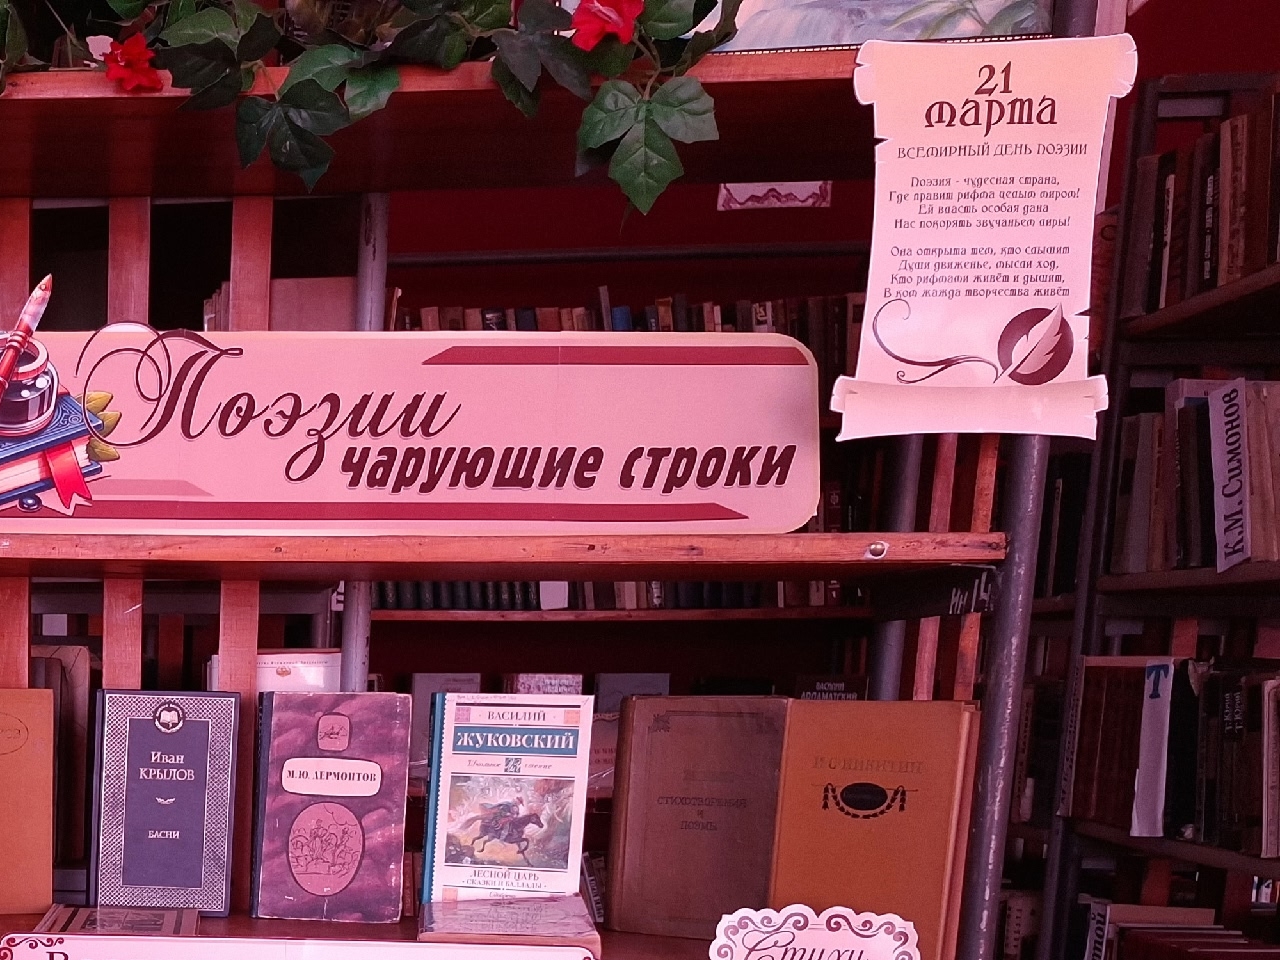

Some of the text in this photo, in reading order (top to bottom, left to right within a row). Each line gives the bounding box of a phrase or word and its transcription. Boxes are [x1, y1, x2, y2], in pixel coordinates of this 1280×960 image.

[975, 61, 1012, 96] 21
[925, 95, 1057, 137] марта
[898, 142, 1087, 159] ВСЕМИРНЫЙ ДЕНЬ ПОЭЗИИ
[911, 177, 951, 187] Поэзия
[964, 176, 1014, 187] чудесная
[889, 191, 909, 203] Где
[913, 191, 953, 201] правит
[958, 190, 994, 201] рифма
[999, 190, 1036, 199] целым
[918, 203, 1048, 215] Ей власть особая дана
[894, 219, 915, 229] Нас
[919, 218, 972, 230] покорять
[891, 247, 912, 256] Она
[916, 247, 966, 256] открыта
[1000, 247, 1021, 256] кто
[1025, 245, 1070, 255] слышит
[898, 260, 930, 272] Души
[996, 260, 1032, 269] мысли
[891, 275, 912, 284] Кто
[916, 274, 969, 285] рифмами
[1013, 275, 1019, 283] и
[884, 288, 891, 297] В
[895, 290, 917, 300] ком
[922, 288, 961, 299] жажда
[965, 288, 1029, 297] творчества
[75, 322, 461, 481] Поэзии
[340, 442, 797, 497] чарующие строки
[1221, 387, 1246, 562] К.М. Симонов
[1145, 663, 1170, 699] Т
[487, 710, 546, 722] ВАСИЛИЙ
[456, 731, 575, 749] ЖУКОВСКИЙ
[150, 751, 184, 764] Иван
[138, 767, 195, 781] КРЫЛОВ
[311, 770, 377, 782] ЛЕРМОНТОВ
[148, 830, 180, 839] БАСНИ
[470, 869, 539, 881] ЛЕСНОЙ ЦАРЬ
